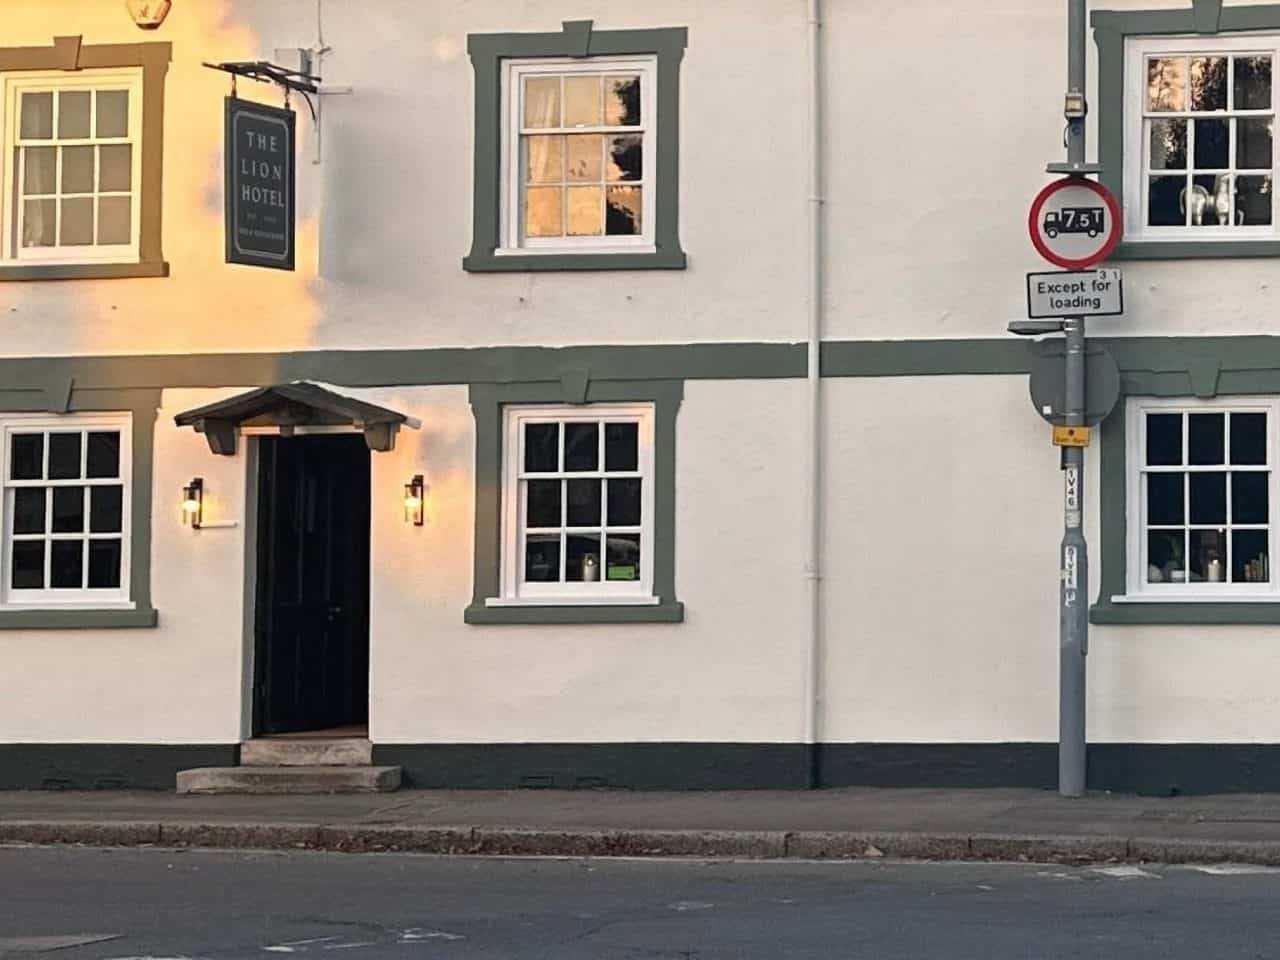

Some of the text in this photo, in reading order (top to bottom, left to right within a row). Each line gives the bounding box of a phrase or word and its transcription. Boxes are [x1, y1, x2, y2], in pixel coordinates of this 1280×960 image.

[246, 131, 279, 153] THE
[241, 157, 282, 181] LION
[241, 184, 285, 208] HOTEL
[1037, 279, 1111, 295] Except for
[1050, 296, 1101, 310] loading
